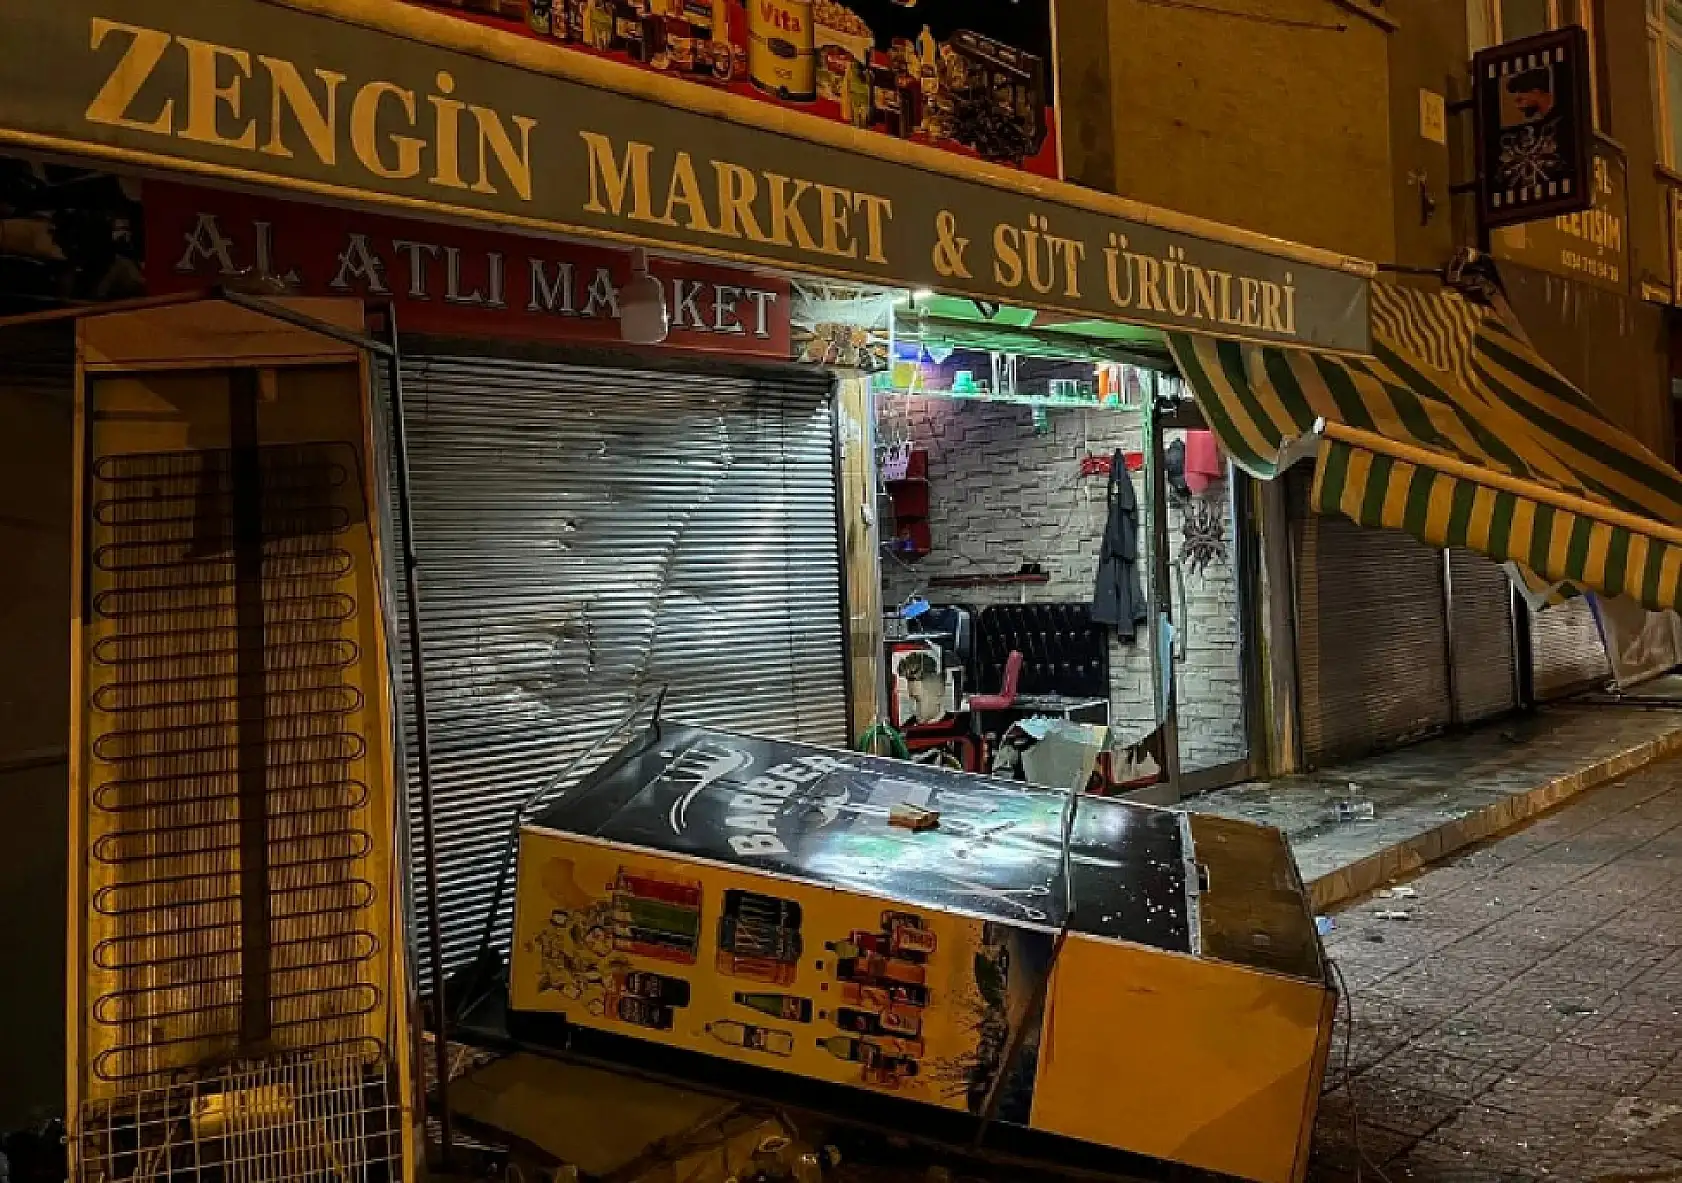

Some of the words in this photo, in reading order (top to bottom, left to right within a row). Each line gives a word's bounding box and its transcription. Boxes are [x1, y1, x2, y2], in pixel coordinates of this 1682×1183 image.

[761, 2, 801, 31] Vita
[85, 17, 537, 200] ZENGİN
[579, 130, 892, 264] MARKET
[933, 210, 973, 279] &
[993, 214, 1085, 298] SÜT
[1103, 232, 1297, 334] ÜRÜNLERİ
[527, 258, 777, 338] MAKET
[725, 757, 859, 856] BARBER
